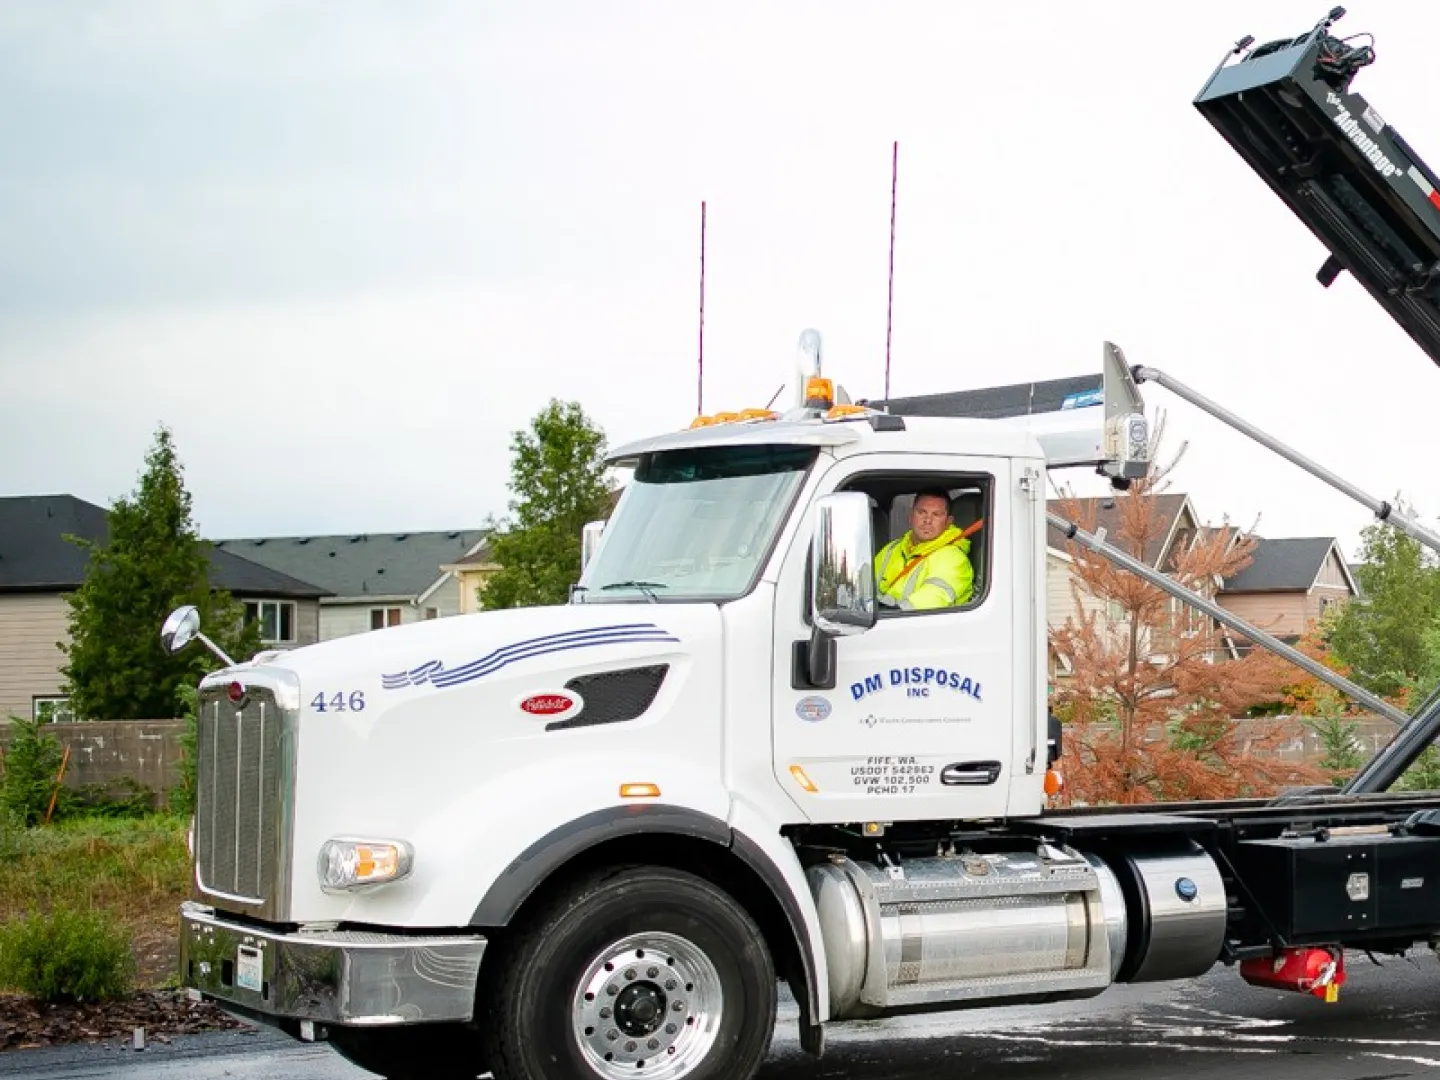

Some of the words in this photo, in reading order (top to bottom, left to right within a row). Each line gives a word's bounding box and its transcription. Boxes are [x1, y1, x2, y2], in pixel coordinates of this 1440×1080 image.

[850, 673, 884, 701] DM
[889, 666, 984, 701] DISPOSAL
[906, 686, 930, 697] INC
[310, 690, 366, 713] 446
[851, 766, 889, 775] USDOT
[854, 776, 881, 785] GVW
[901, 786, 915, 794] 17
